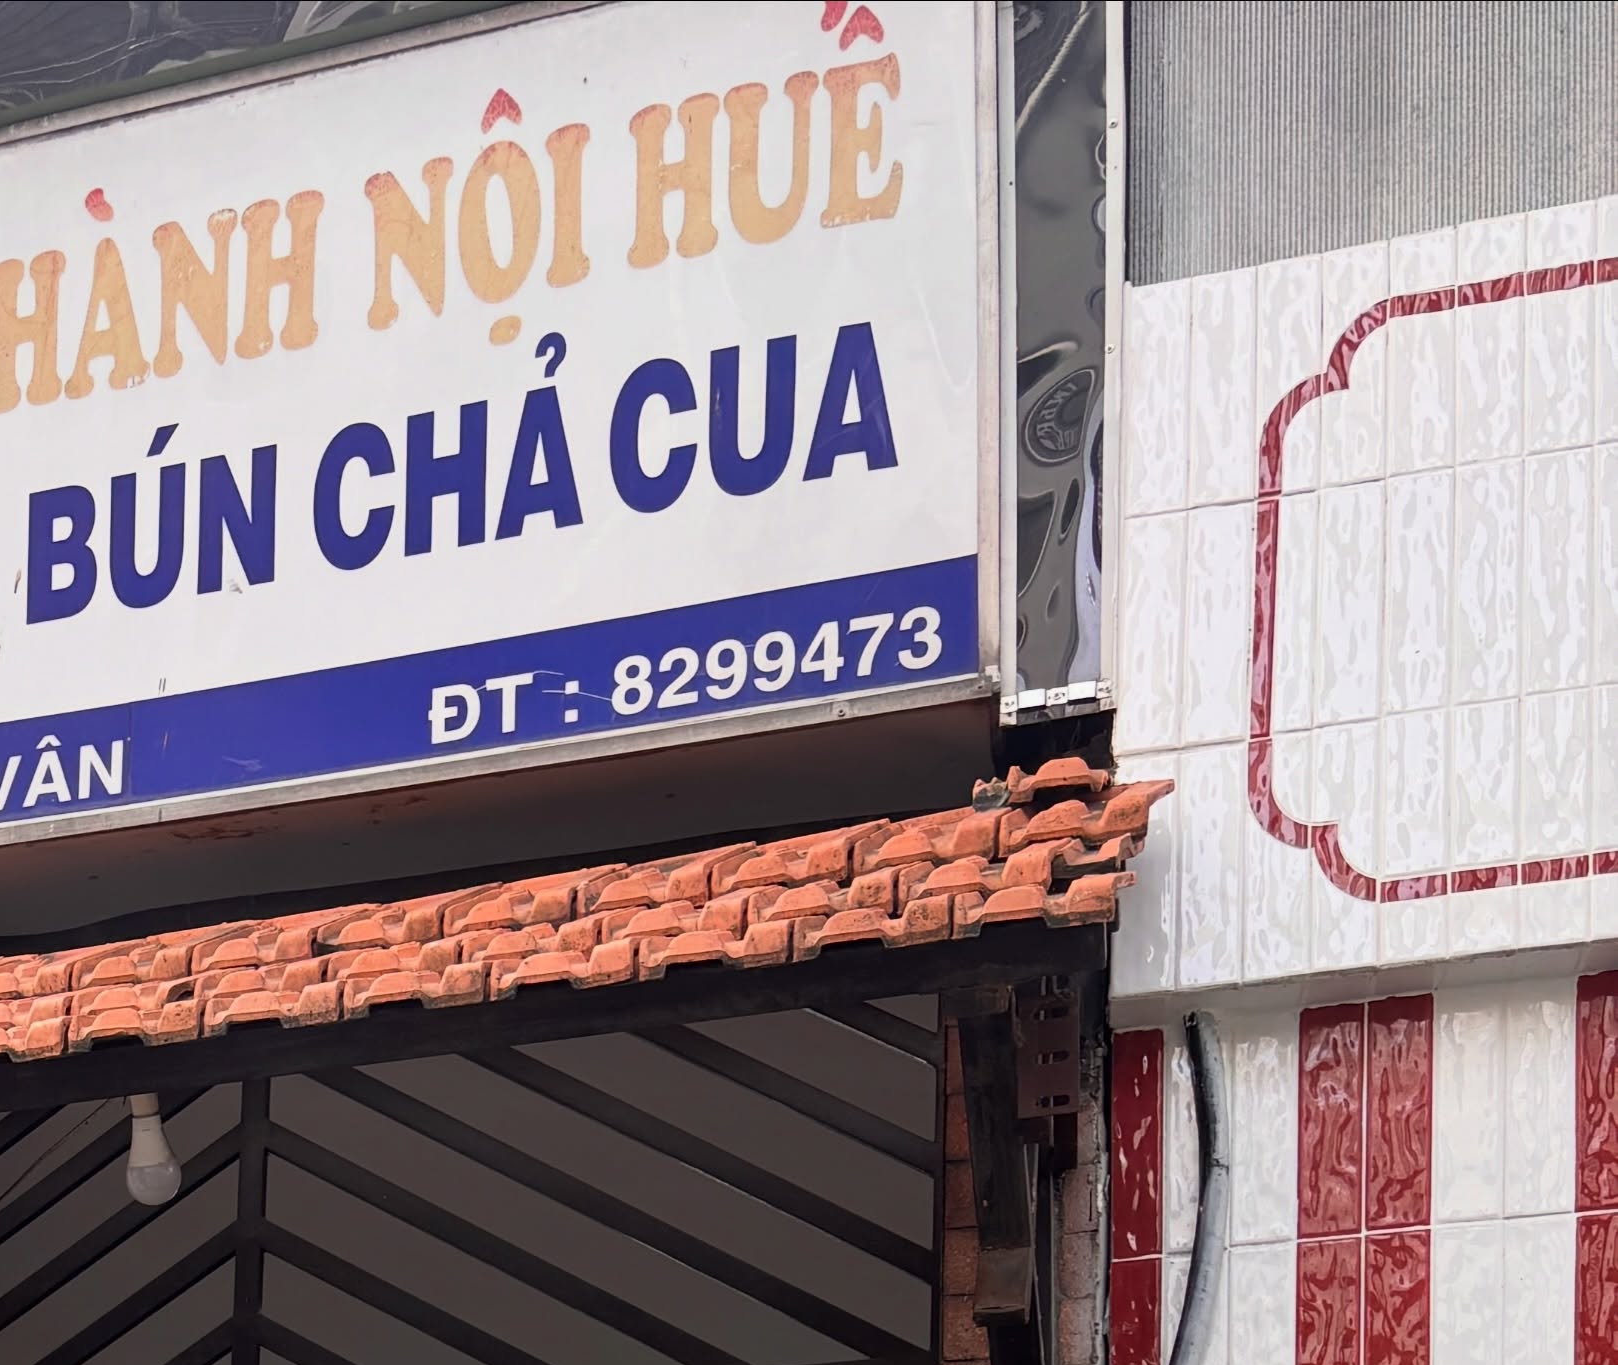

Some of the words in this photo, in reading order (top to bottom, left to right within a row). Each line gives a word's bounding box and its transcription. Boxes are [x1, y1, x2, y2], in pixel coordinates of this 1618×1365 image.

[364, 87, 590, 346] NỘI
[627, 0, 903, 270] HUẾ
[25, 422, 278, 626] BÚN
[312, 331, 584, 571] CHẢ
[608, 320, 900, 514] CUA
[611, 605, 944, 717] 8299473
